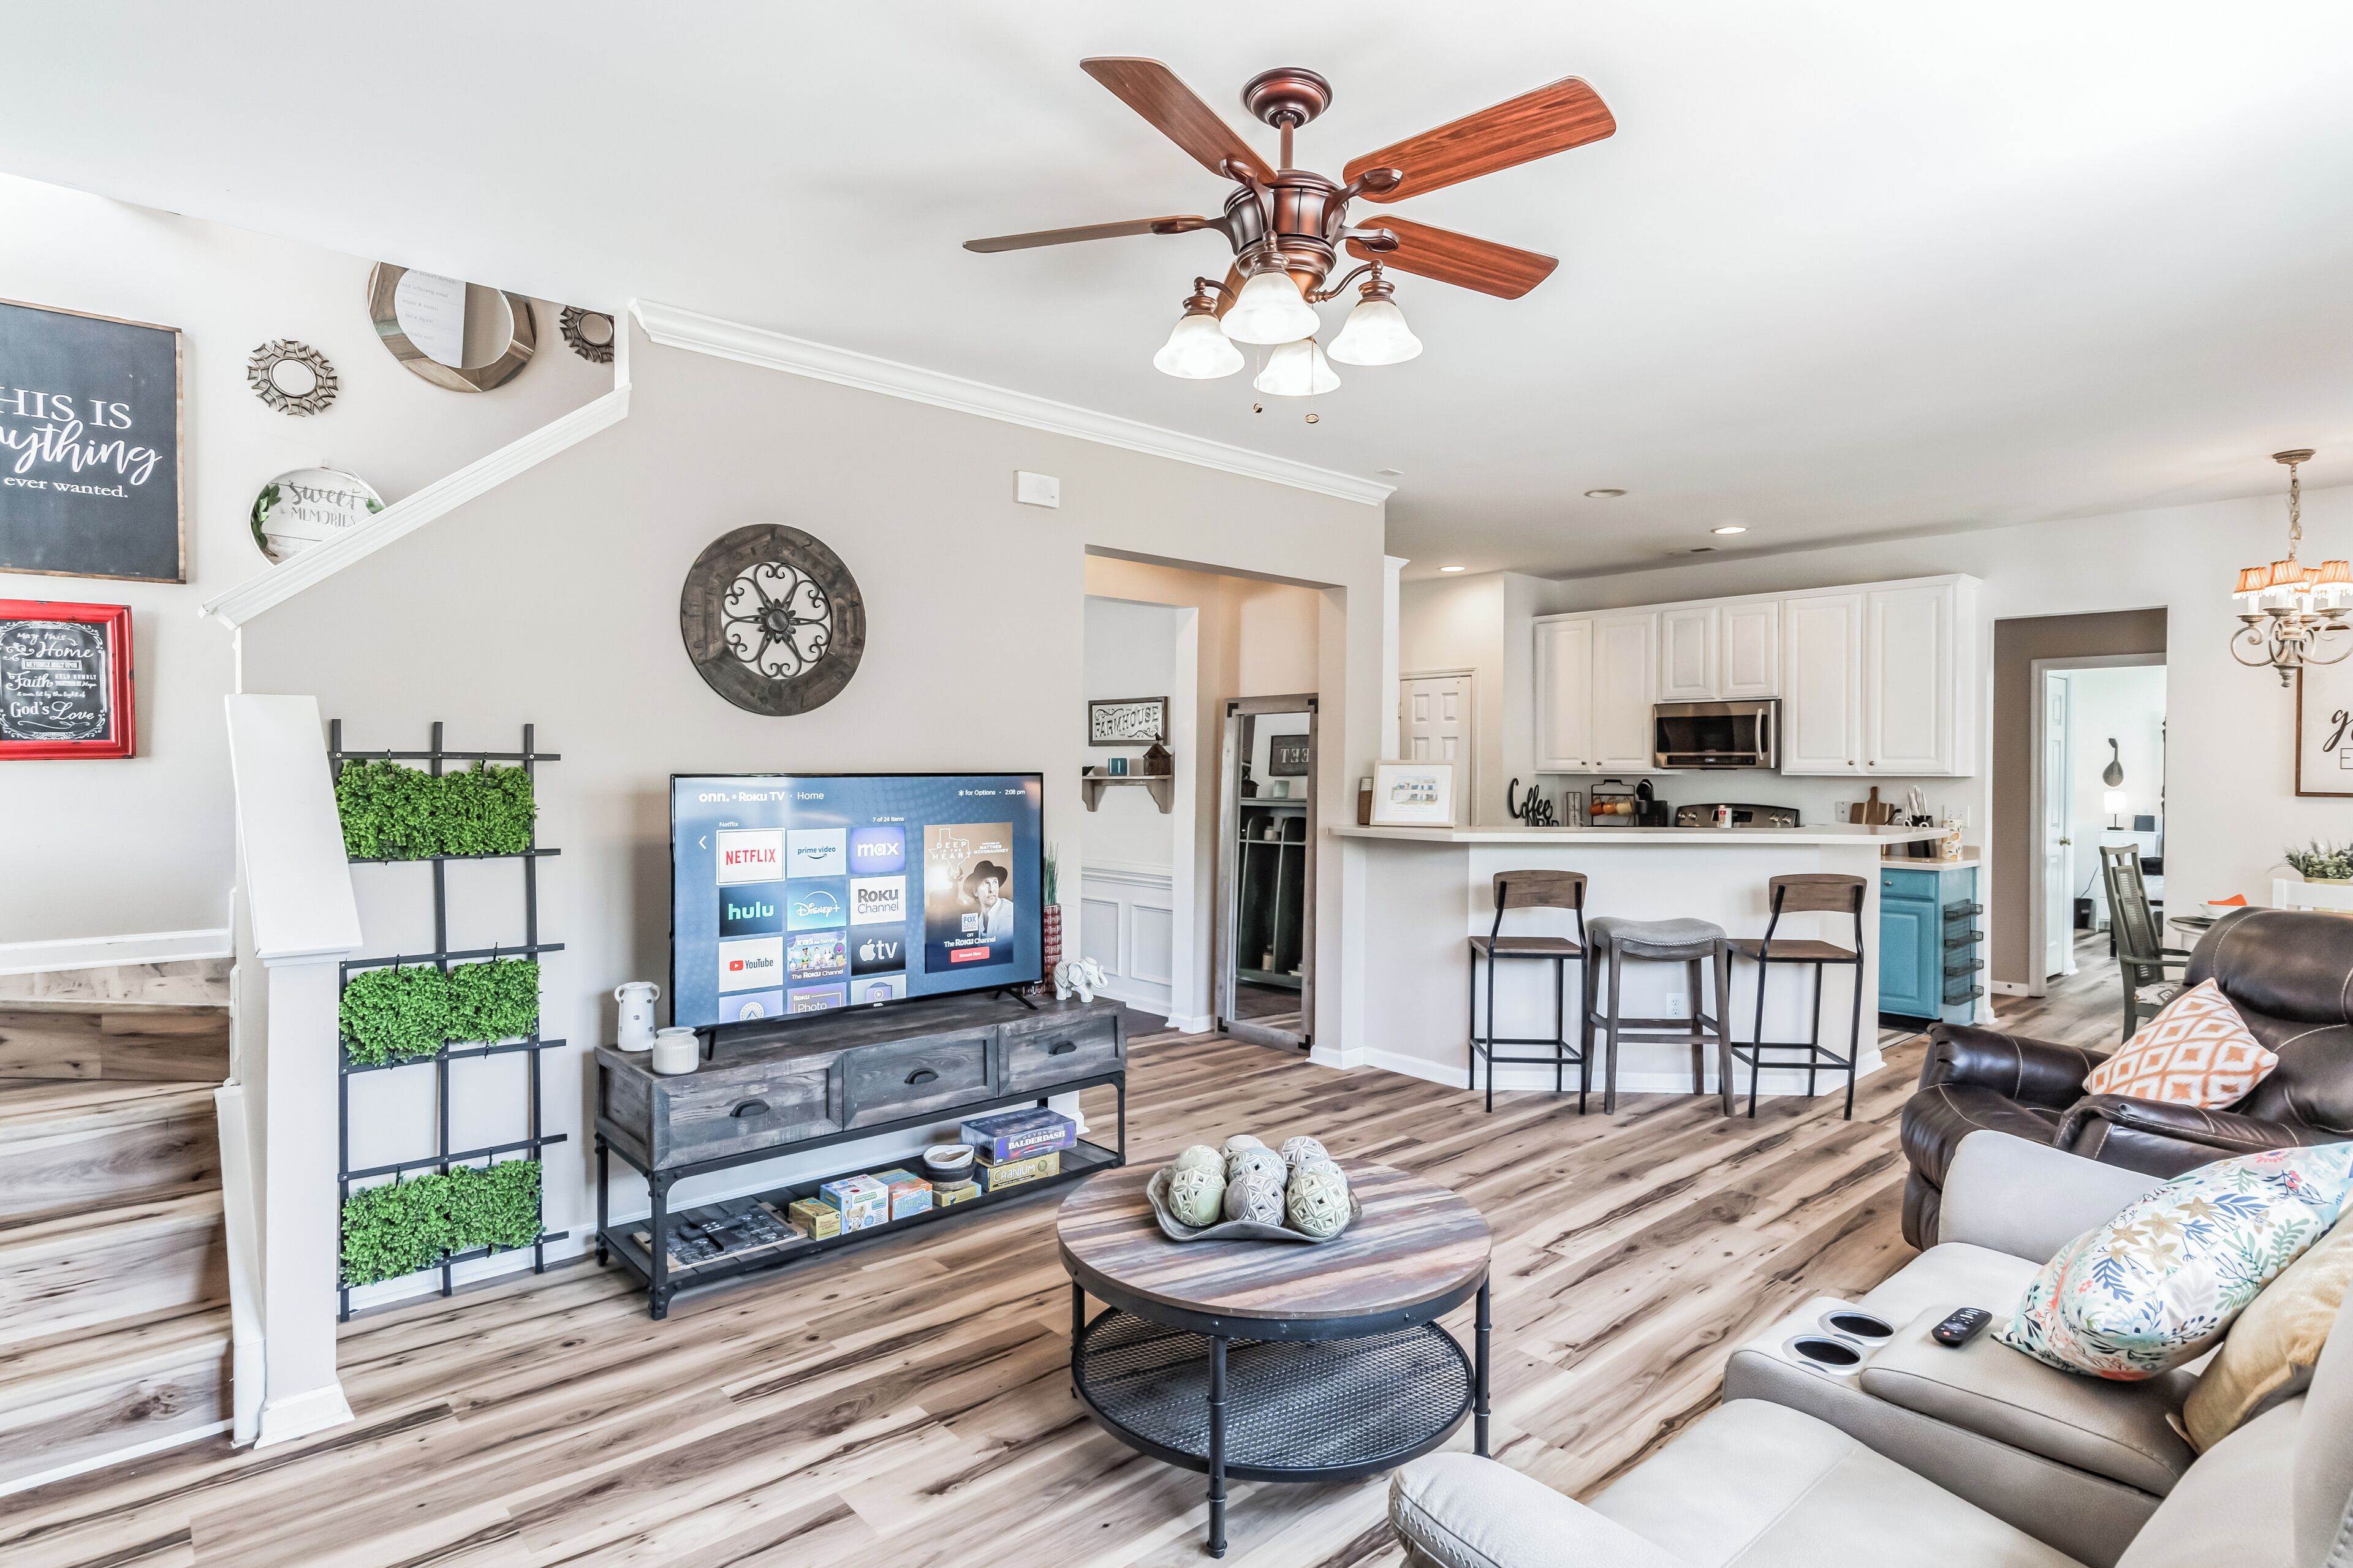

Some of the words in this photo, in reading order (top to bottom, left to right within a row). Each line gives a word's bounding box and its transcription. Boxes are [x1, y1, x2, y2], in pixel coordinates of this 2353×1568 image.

[89, 399, 132, 430] IS
[4, 477, 48, 490] ever
[53, 482, 128, 498] wanted.
[291, 507, 355, 528] MEMORIES
[36, 641, 94, 658] Home
[6, 670, 53, 691] Faith
[10, 702, 50, 718] God's
[50, 701, 94, 720] Love
[1096, 706, 1159, 737] FARMHOUSE
[699, 793, 730, 803] onn.
[770, 791, 786, 801] TV
[1509, 778, 1553, 819] Coffee
[726, 849, 776, 865] NETFLIX
[857, 842, 900, 857] max
[728, 901, 775, 920] hulu
[858, 900, 899, 914] Channel
[876, 939, 898, 960] tv
[745, 958, 773, 969] YouTube
[798, 1001, 827, 1012] Photo
[1008, 1131, 1066, 1149] BALDERDASH
[894, 1195, 931, 1214] Charades
